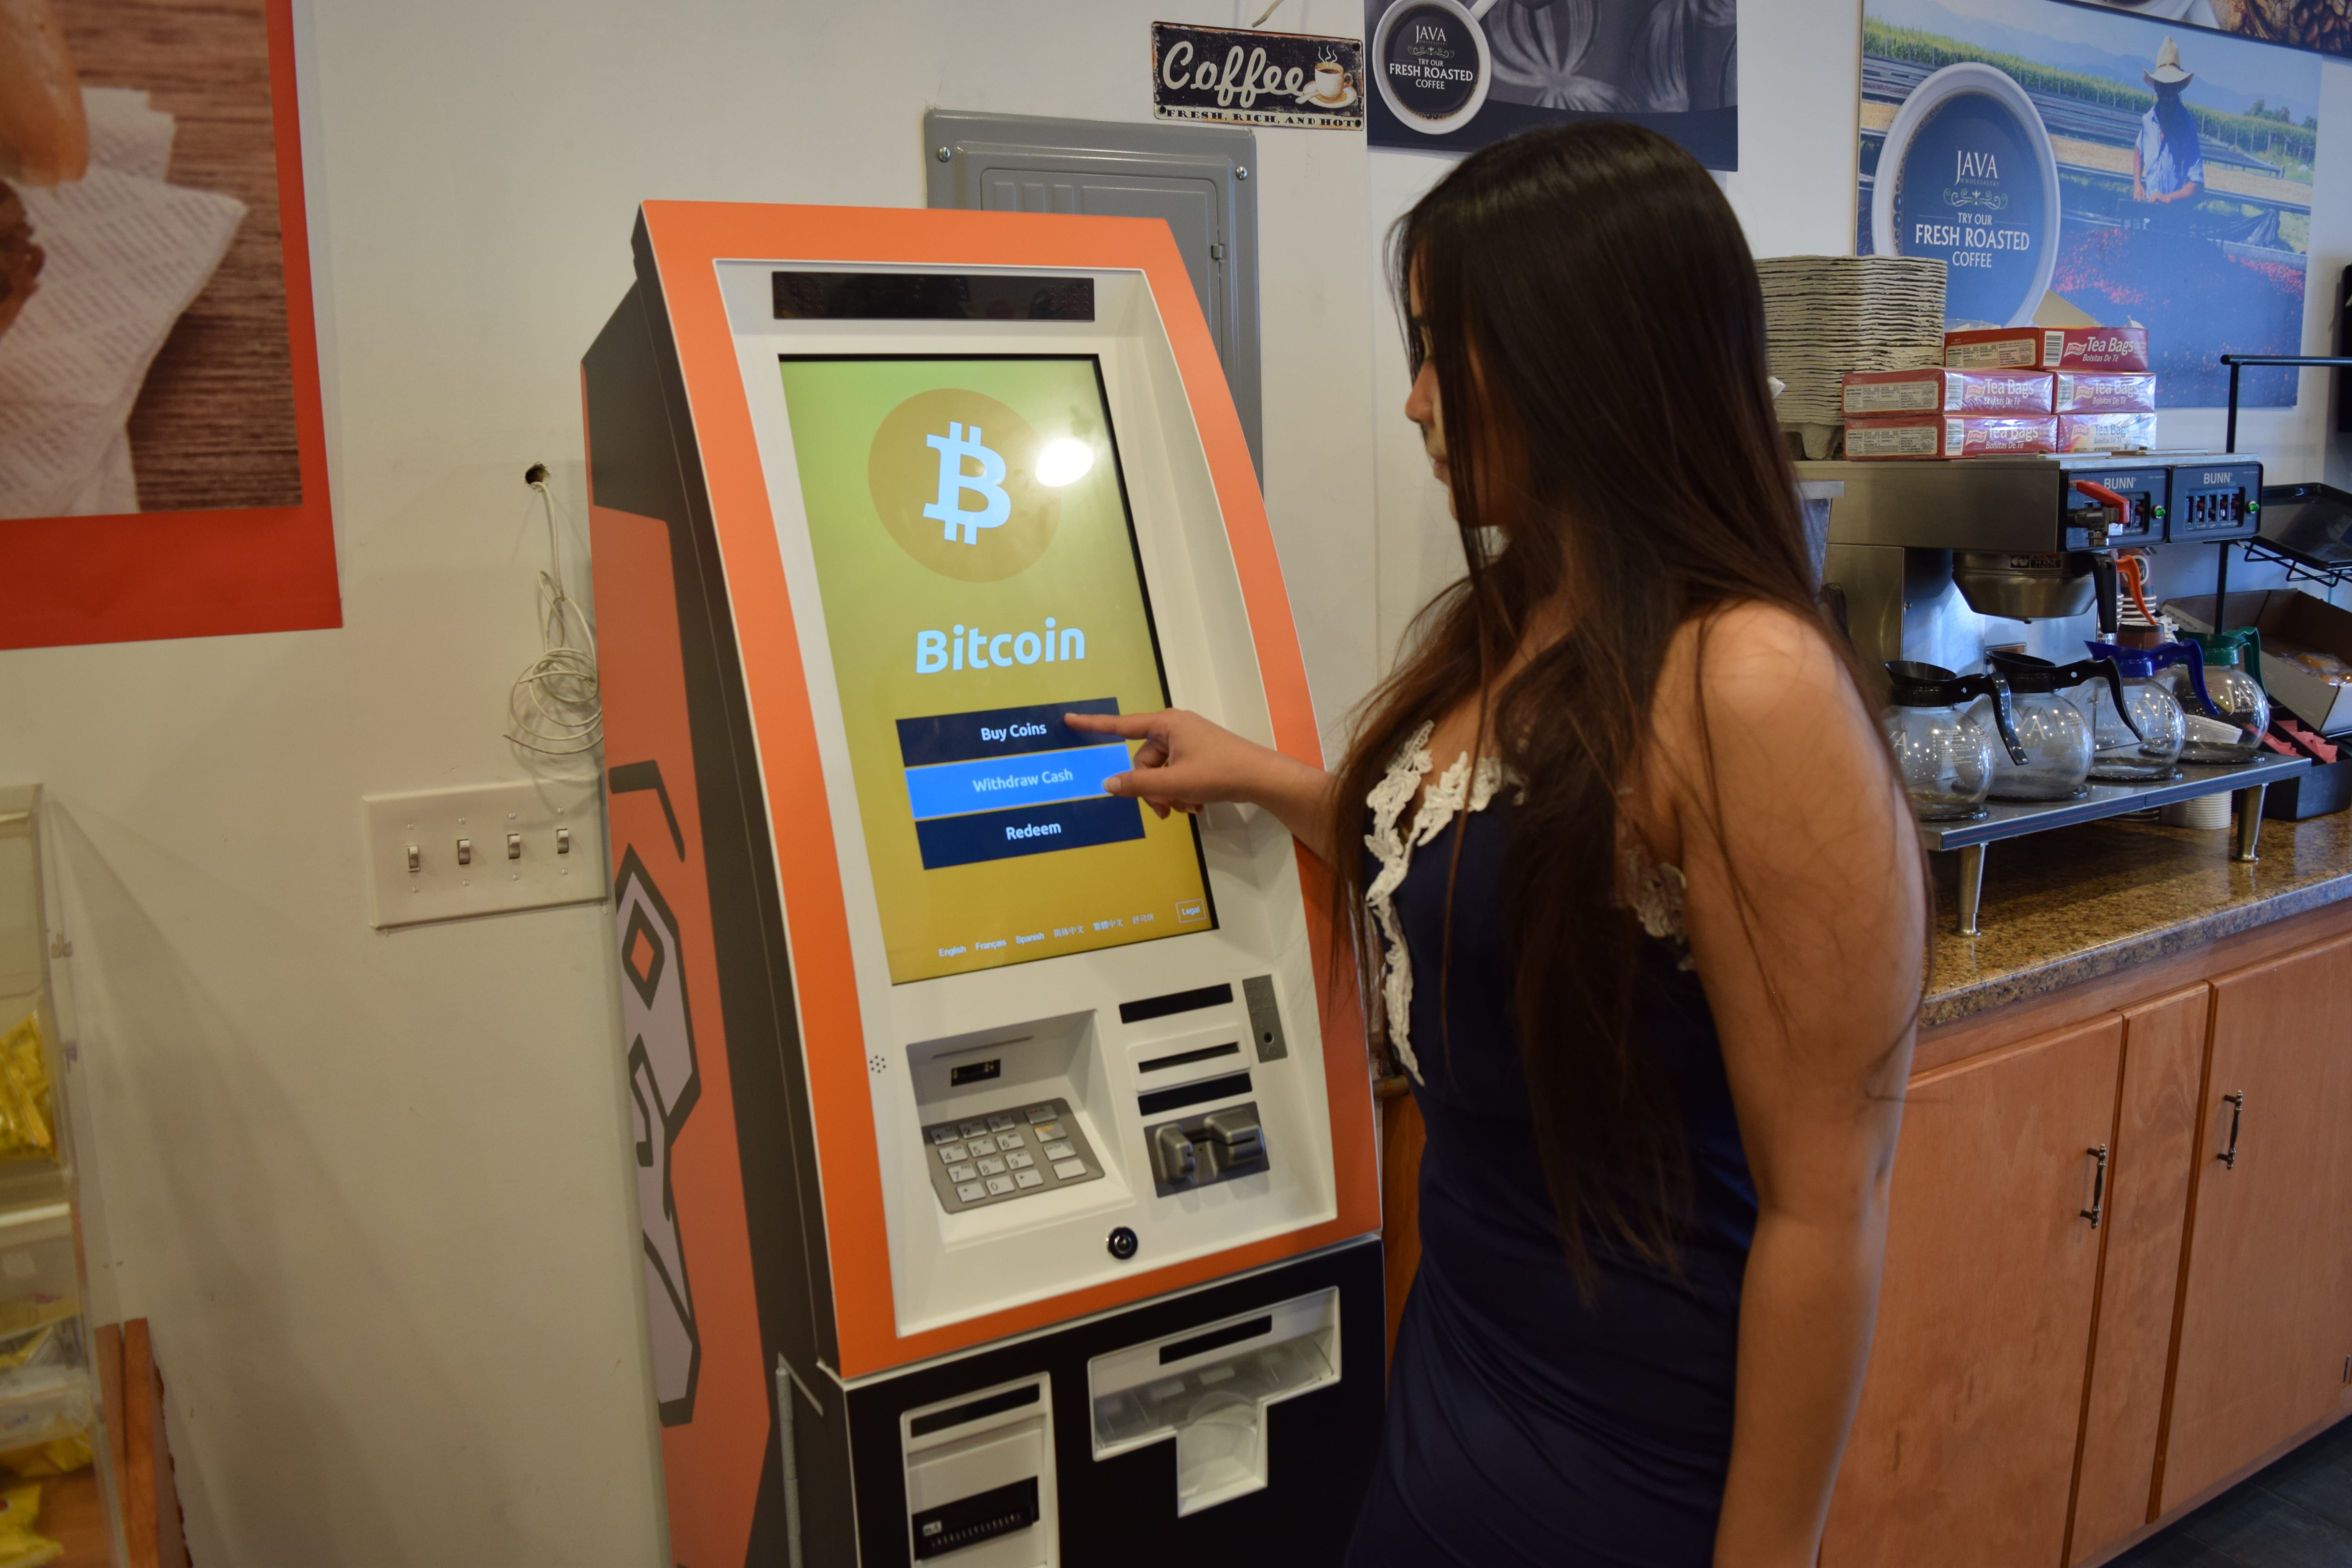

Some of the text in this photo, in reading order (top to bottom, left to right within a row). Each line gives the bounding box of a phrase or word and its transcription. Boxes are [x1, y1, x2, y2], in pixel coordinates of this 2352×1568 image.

[1416, 25, 1446, 44] JAVA
[1163, 41, 1303, 108] Coffee
[1390, 63, 1473, 81] FRESH ROASTED
[1416, 79, 1445, 89] COFFEE
[1166, 110, 1354, 127] FRESH, RICH, AND HOT
[1955, 150, 1999, 185] JAVA
[1958, 212, 1992, 226] TRY OUR
[1915, 224, 2030, 251] FRESH ROASTED
[1953, 251, 1992, 268] COFFEE
[2087, 336, 2106, 352] Tea
[2108, 337, 2134, 356] Bags
[1985, 378, 2034, 399] Tea Bags
[2093, 379, 2139, 398] Tea Bags
[1988, 424, 2007, 439] Tea
[2011, 424, 2038, 442] Bags
[2094, 424, 2129, 437] Tea Bags
[2203, 472, 2230, 484] BUNN
[916, 617, 1085, 674] Bitcoin
[981, 722, 1047, 742] Buy Coins
[973, 768, 1073, 793] Withdraw Cash
[1006, 822, 1062, 840] Redeem
[1181, 906, 1200, 916] Legal
[938, 932, 1044, 957] English Français Spanish
